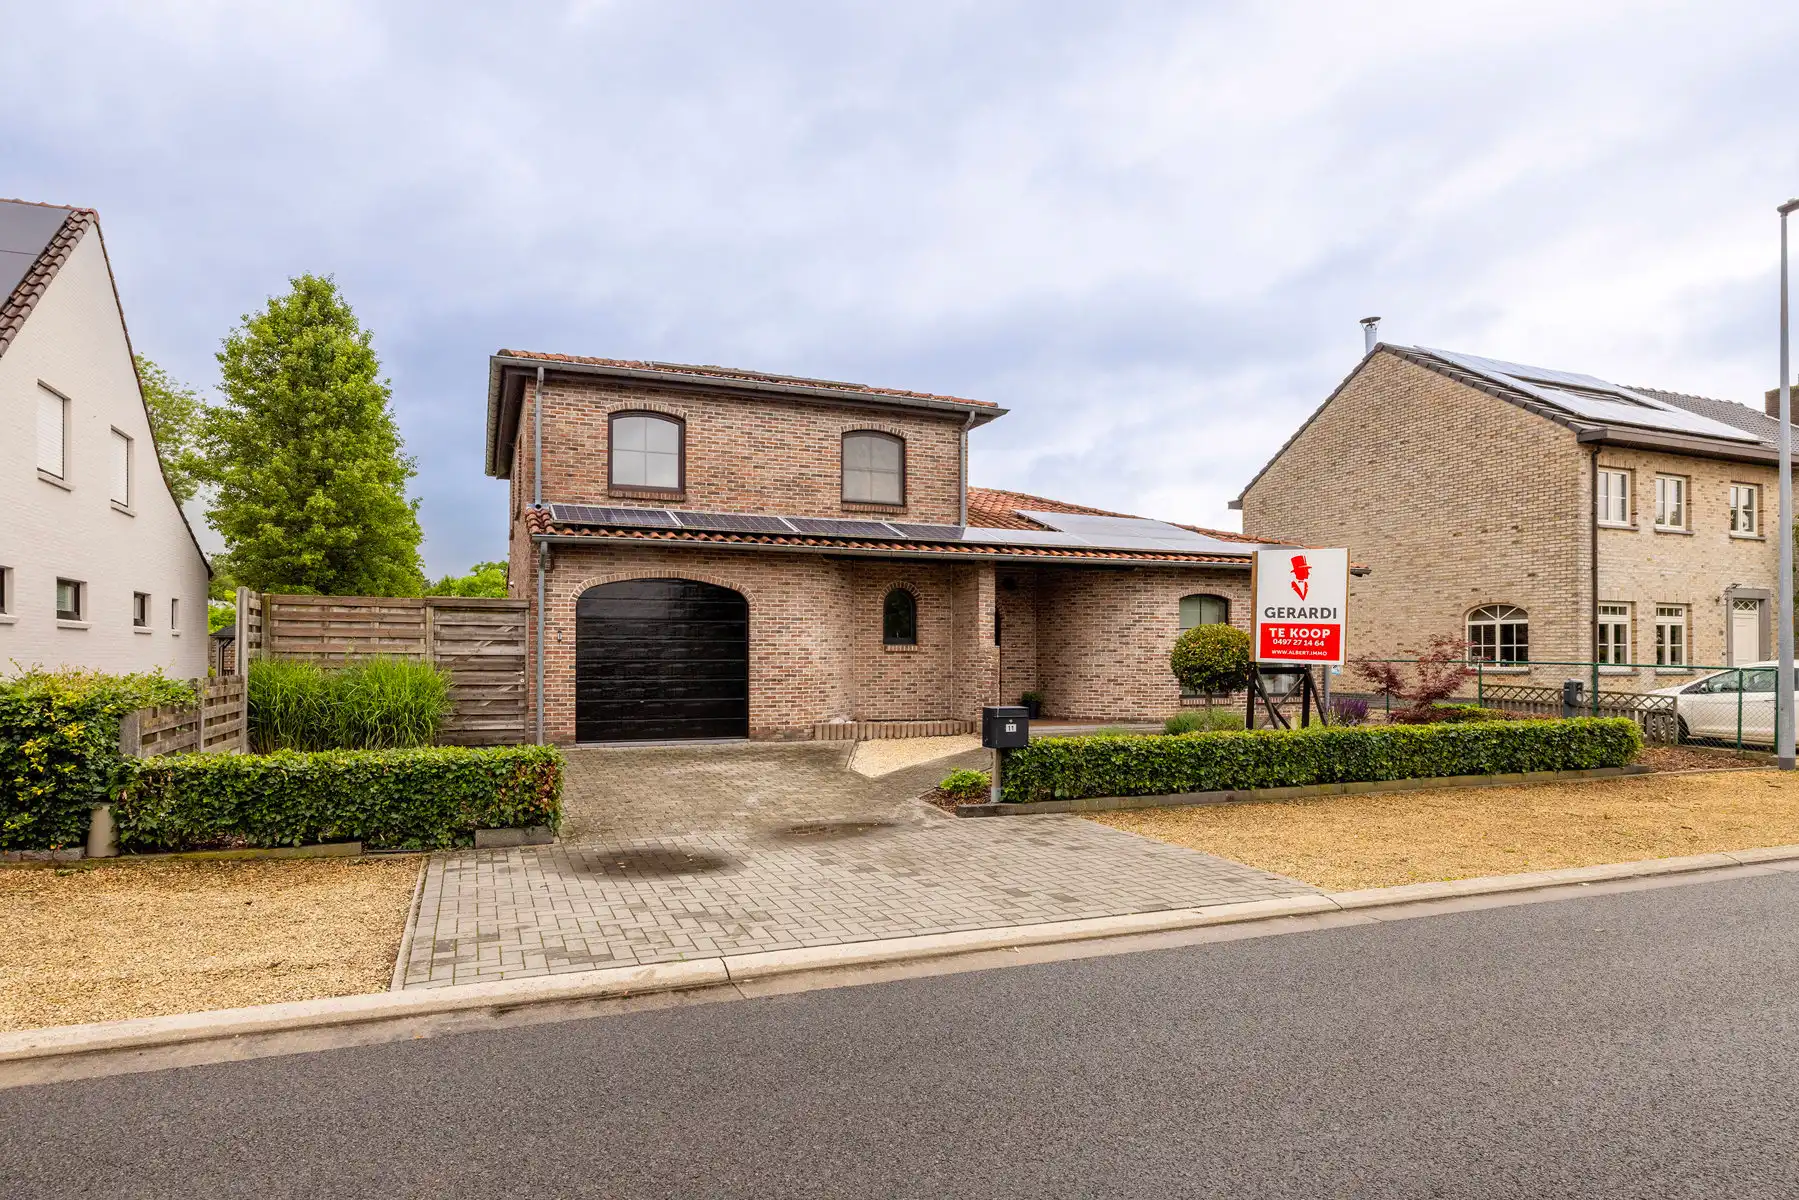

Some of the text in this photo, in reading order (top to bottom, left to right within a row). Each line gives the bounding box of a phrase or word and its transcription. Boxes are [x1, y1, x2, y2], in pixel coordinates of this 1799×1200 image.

[1264, 607, 1337, 619] GERARDI
[1269, 627, 1331, 638] TE KOOP
